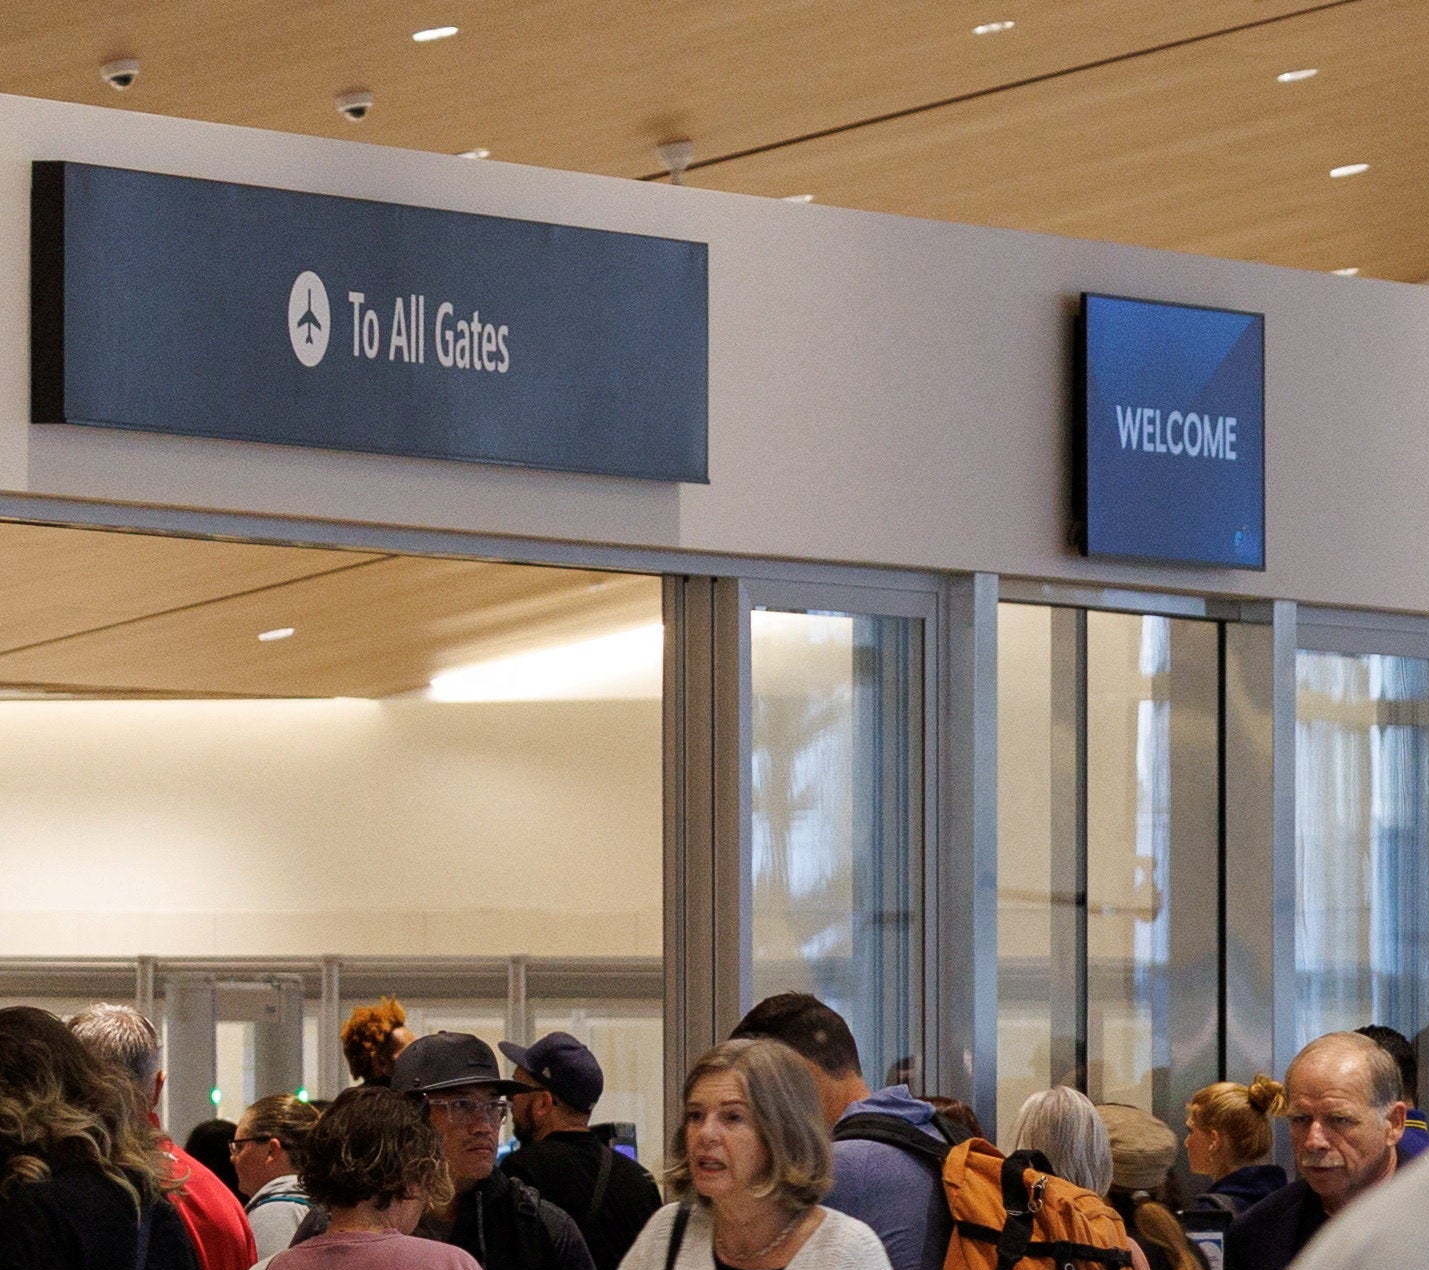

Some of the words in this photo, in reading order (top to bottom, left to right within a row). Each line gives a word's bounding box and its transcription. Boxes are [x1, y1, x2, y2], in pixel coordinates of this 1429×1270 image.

[348, 291, 380, 359] To
[388, 294, 425, 364] All
[435, 301, 510, 374] Gates
[1115, 404, 1238, 460] WELCOME
